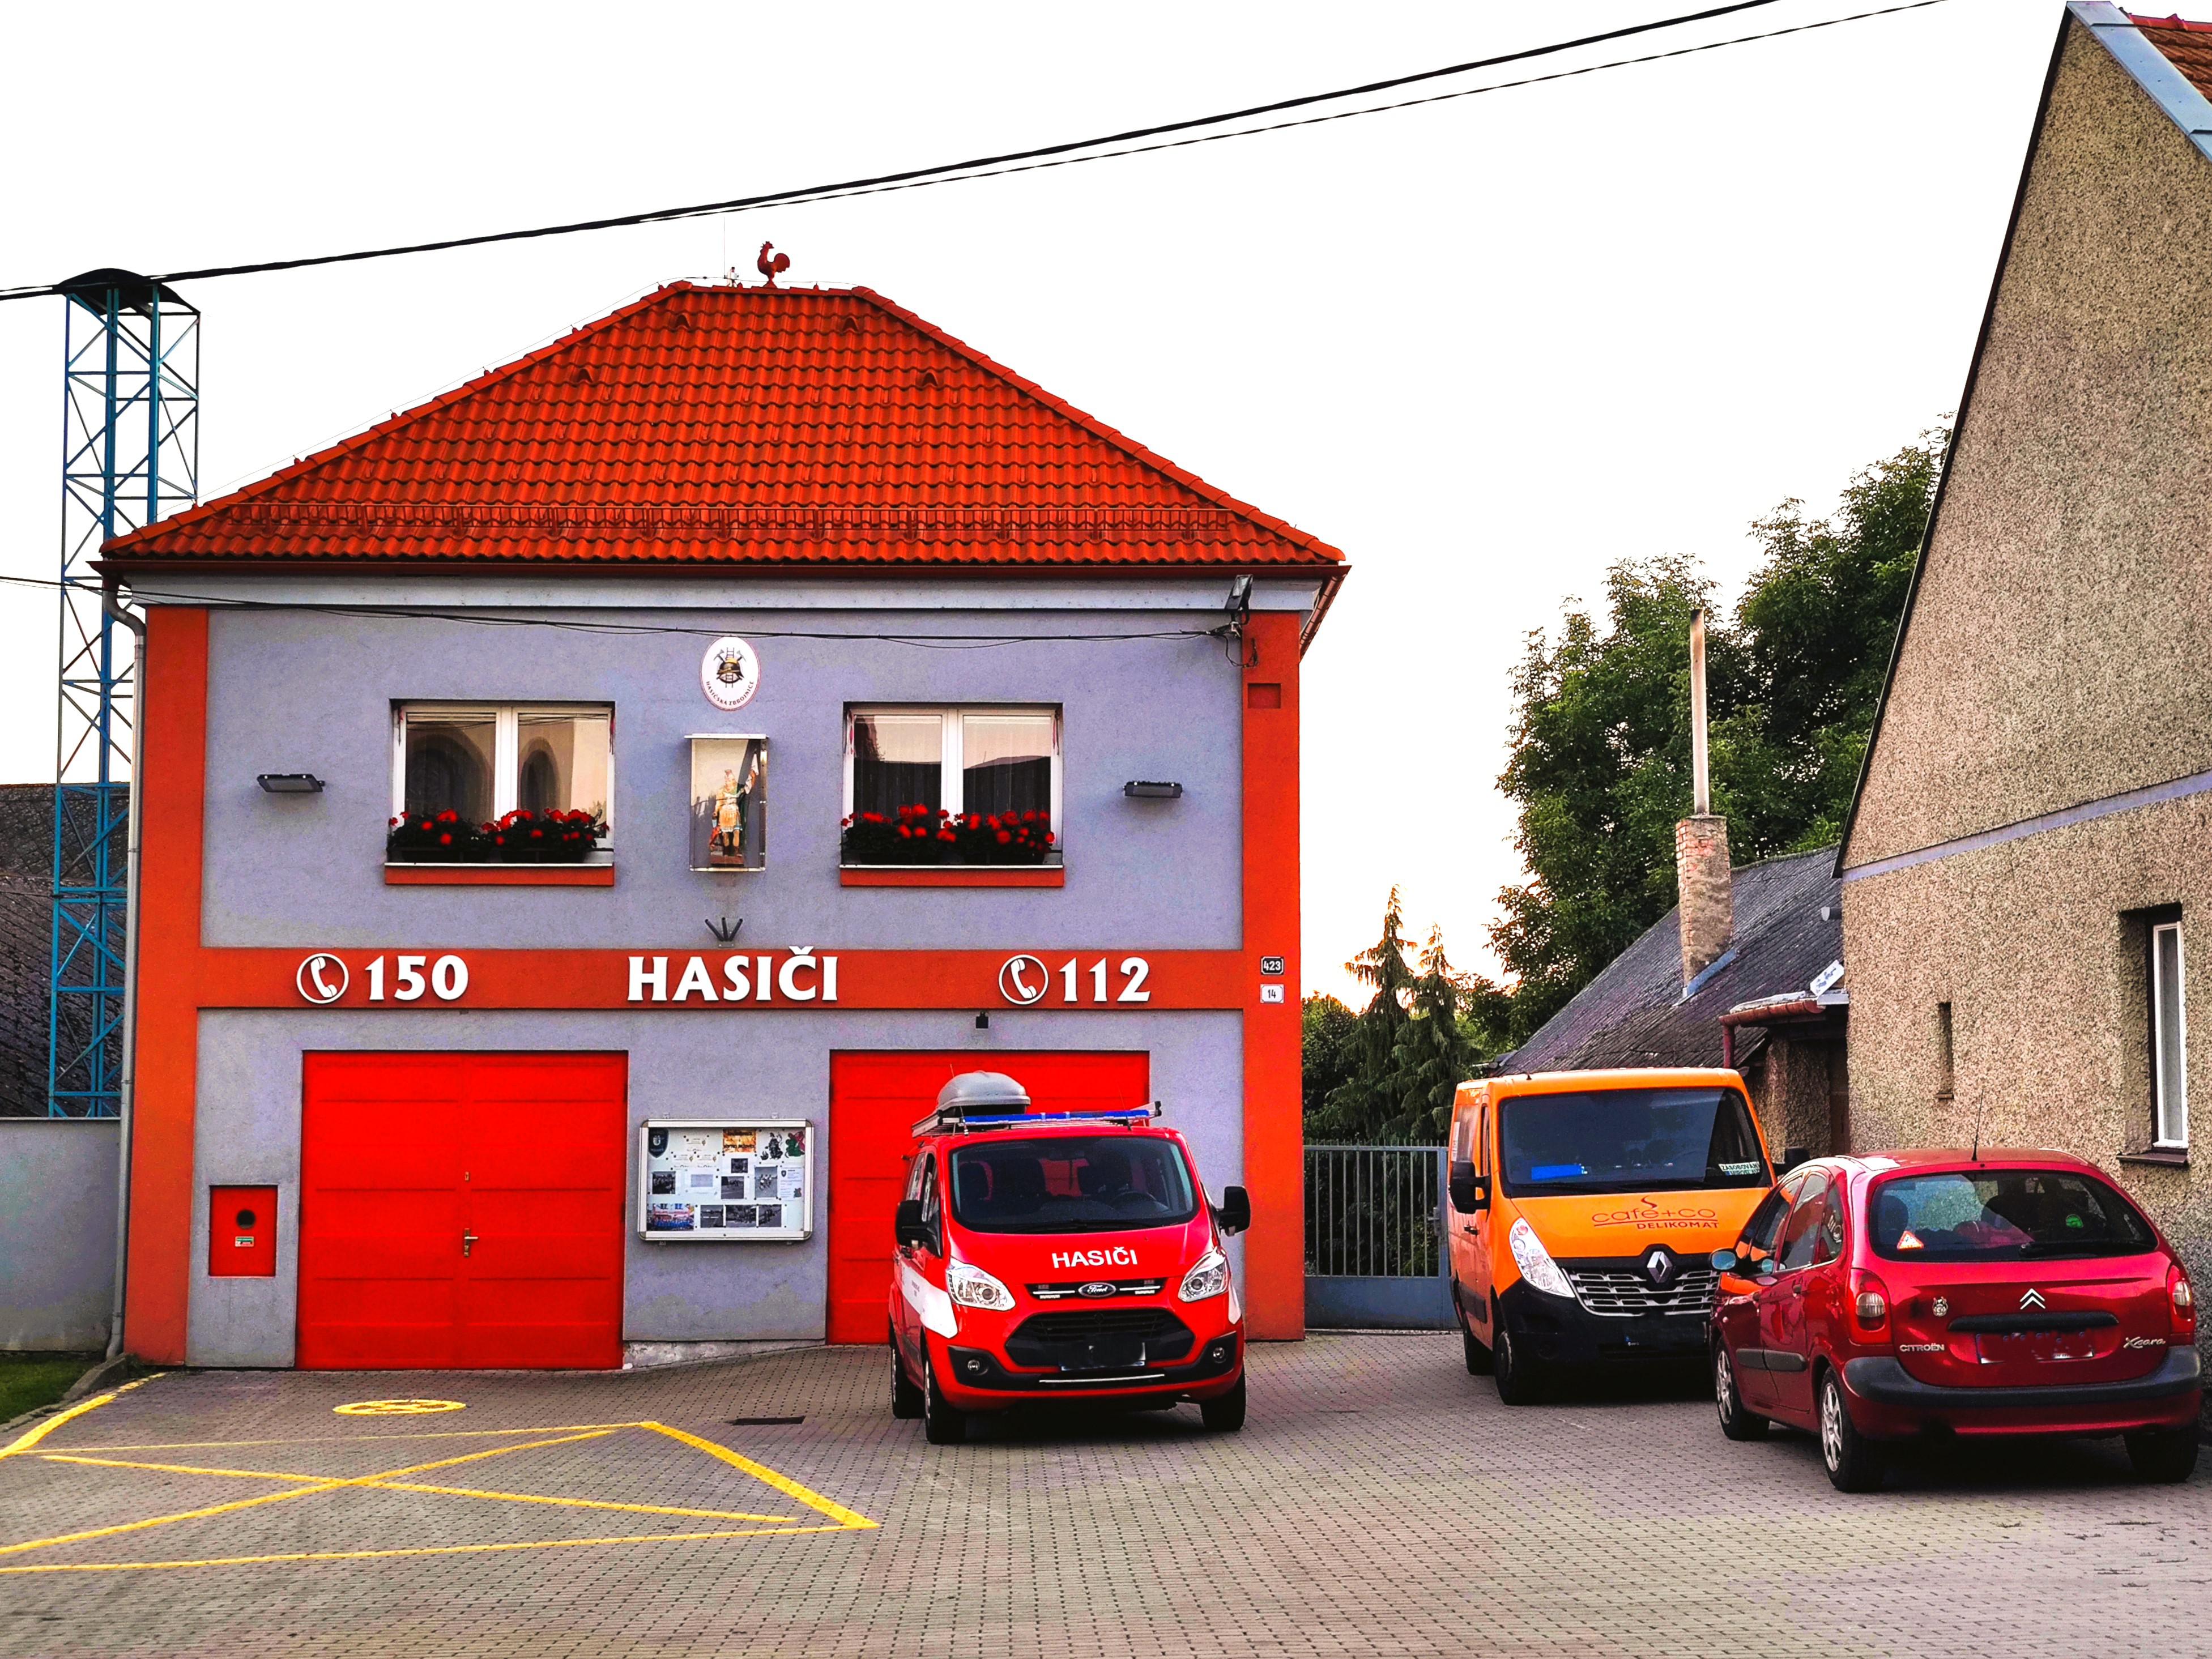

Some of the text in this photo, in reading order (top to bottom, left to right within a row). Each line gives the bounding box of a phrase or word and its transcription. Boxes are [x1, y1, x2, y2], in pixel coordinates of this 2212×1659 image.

[1263, 961, 1281, 971] 423
[364, 955, 469, 1001] 150
[627, 945, 838, 1002] HASIČI
[1058, 957, 1151, 1001] 112
[1267, 989, 1276, 999] 14
[1636, 1221, 1719, 1230] DELIKOMAT
[1051, 1246, 1138, 1269] HASIČI
[1899, 1342, 1945, 1352] CITROËN
[2123, 1336, 2166, 1349] Xsara
